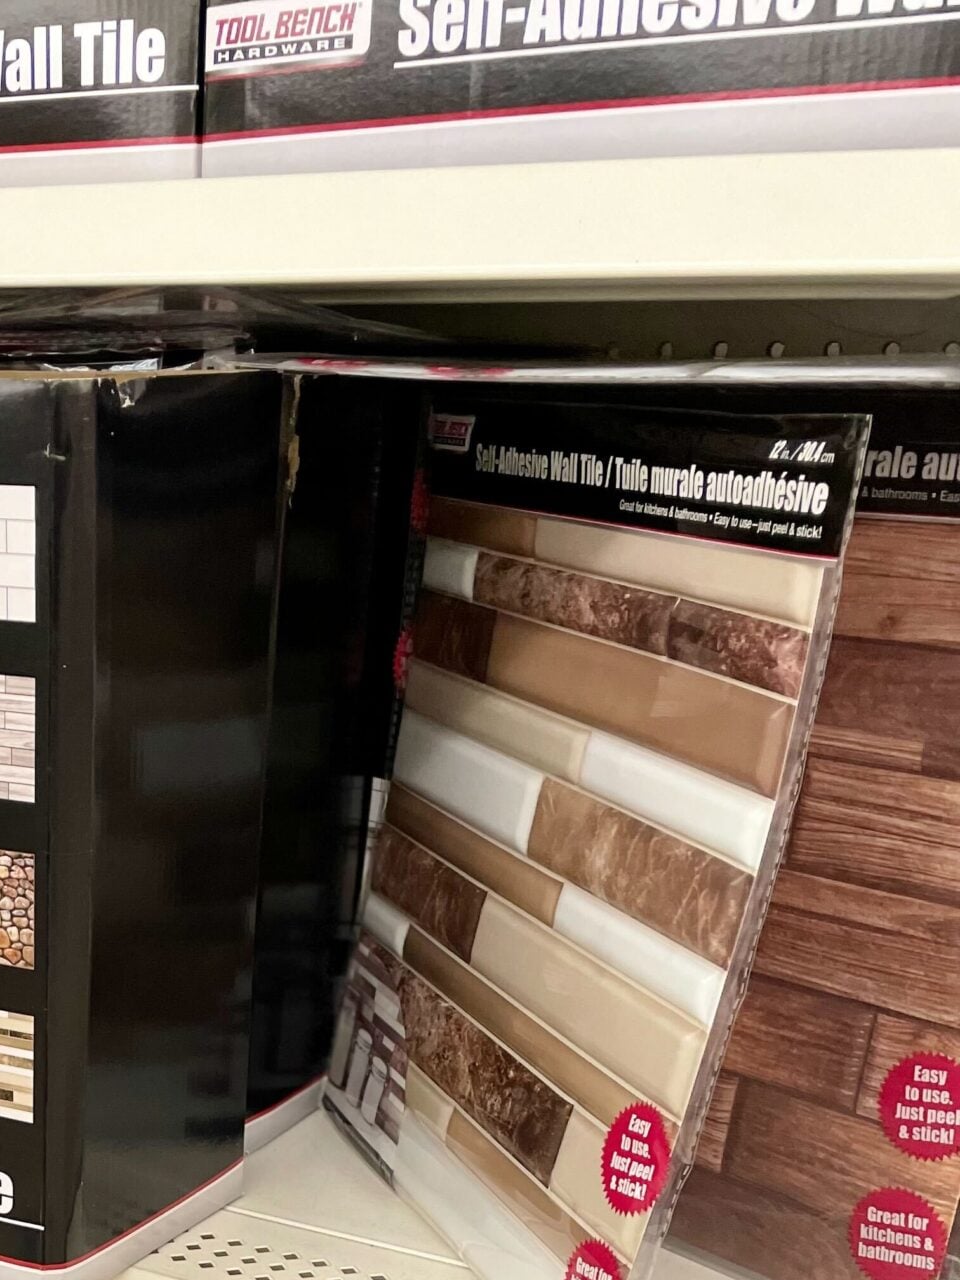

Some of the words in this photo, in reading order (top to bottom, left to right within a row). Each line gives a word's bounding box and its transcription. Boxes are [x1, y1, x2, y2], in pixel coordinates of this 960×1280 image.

[215, 17, 274, 46] TOOL
[277, 4, 355, 36] BENCH
[74, 20, 166, 84] Tile
[216, 38, 346, 63] HARDWARE
[769, 440, 788, 460] 12
[798, 440, 826, 462] 30.4
[820, 452, 835, 464] cm
[475, 442, 549, 481] Self-Adhesive
[550, 450, 578, 484] Wall
[580, 454, 603, 488] Tile
[605, 458, 613, 490] /
[614, 456, 648, 492] Tuile
[650, 464, 704, 500] murale
[706, 469, 830, 516] autoadhésive
[872, 488, 928, 501] bathrooms
[619, 499, 635, 513] Great
[635, 500, 644, 513] for
[644, 501, 668, 517] kitchens
[668, 505, 674, 518] &
[674, 506, 708, 523] bathrooms
[713, 512, 730, 530] Easy
[731, 514, 739, 527] to
[771, 522, 788, 536] peel
[788, 523, 795, 536] &
[796, 524, 822, 539] stick!
[913, 1065, 948, 1086] Easy
[905, 1085, 920, 1101] to
[922, 1087, 953, 1105] use.
[628, 1114, 652, 1138] Easy
[895, 1102, 924, 1121] Just
[927, 1107, 960, 1126] peel
[621, 1134, 631, 1151] to
[631, 1139, 651, 1159] use.
[899, 1125, 910, 1139] &
[912, 1125, 955, 1144] stick!
[610, 1152, 630, 1174] Just
[630, 1159, 655, 1182] peel
[610, 1174, 617, 1190] &
[617, 1178, 647, 1200] stick!
[867, 1206, 906, 1226] Great
[908, 1211, 929, 1231] for
[860, 1223, 922, 1248] kitchens
[924, 1237, 935, 1252] &
[858, 1241, 935, 1271] bathrooms
